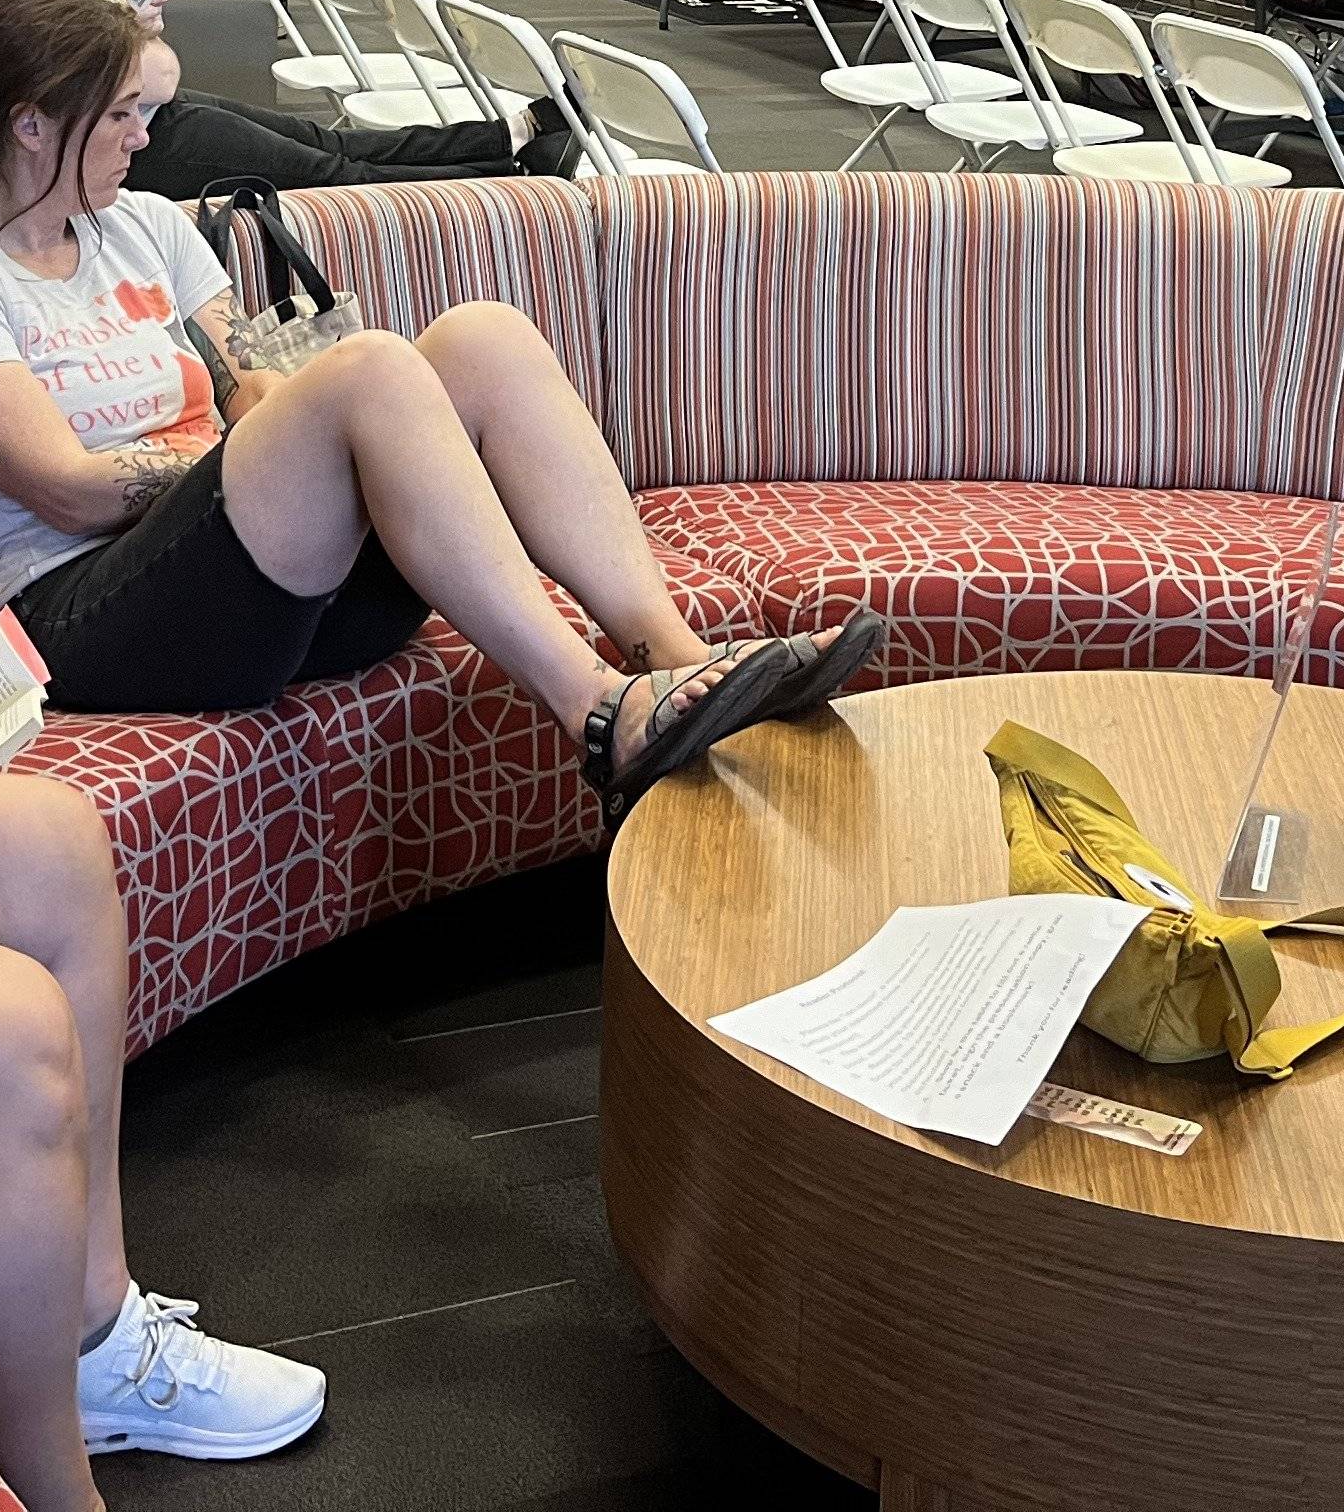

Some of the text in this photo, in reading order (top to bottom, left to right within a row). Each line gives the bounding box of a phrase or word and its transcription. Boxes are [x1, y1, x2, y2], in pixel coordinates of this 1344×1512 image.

[23, 314, 137, 358] Parable
[84, 352, 144, 384] the
[67, 391, 167, 435] ower
[1016, 1032, 1039, 1064] Thank
[1036, 1012, 1053, 1033] you
[1048, 996, 1061, 1012] for
[957, 1061, 982, 1093] snack
[978, 1039, 995, 1060] and
